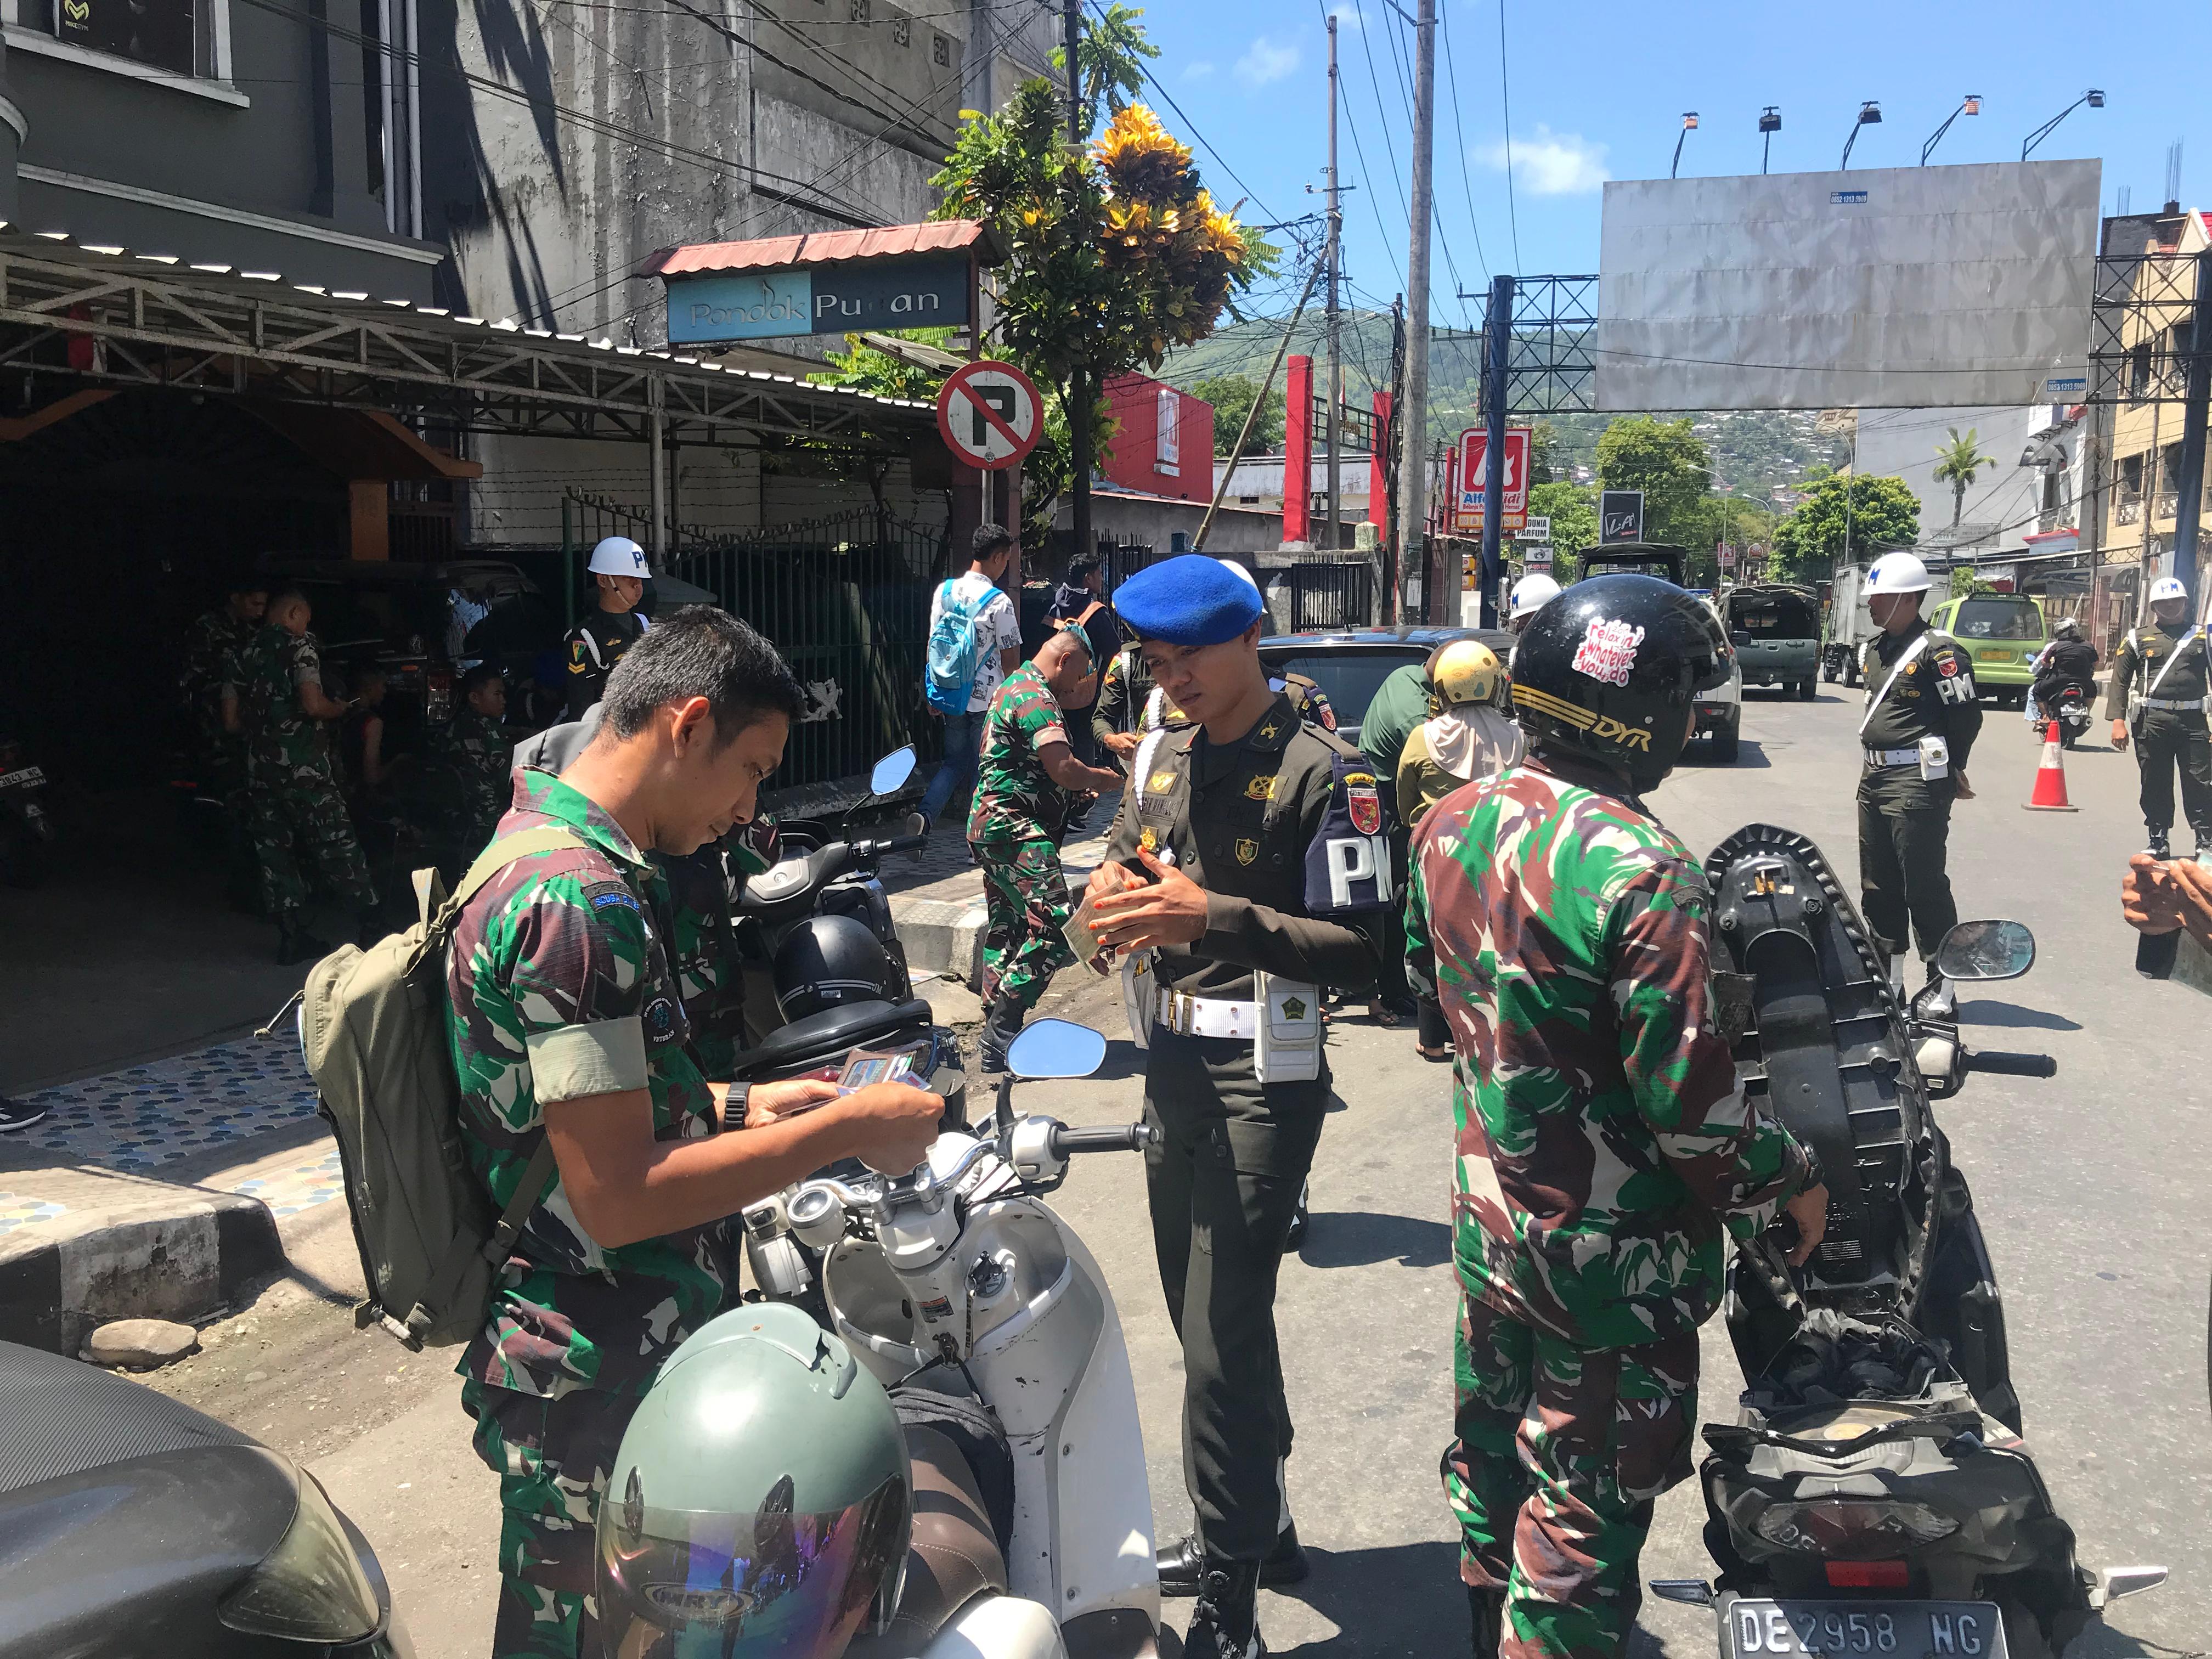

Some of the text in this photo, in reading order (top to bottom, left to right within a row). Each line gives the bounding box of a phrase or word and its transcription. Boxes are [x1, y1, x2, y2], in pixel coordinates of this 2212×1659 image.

[690, 280, 806, 328] Pondok
[1464, 493, 1521, 504] Alfidi
[1517, 529, 1547, 538] PARFUM
[1528, 519, 1547, 528] DUNIA
[1590, 624, 1620, 642] relax
[1588, 639, 1635, 667] whatever
[1579, 657, 1627, 683] you do
[1935, 673, 1976, 705] PM
[1592, 715, 1652, 752] DYR
[1739, 1609, 1980, 1655] DE 2958 NG
